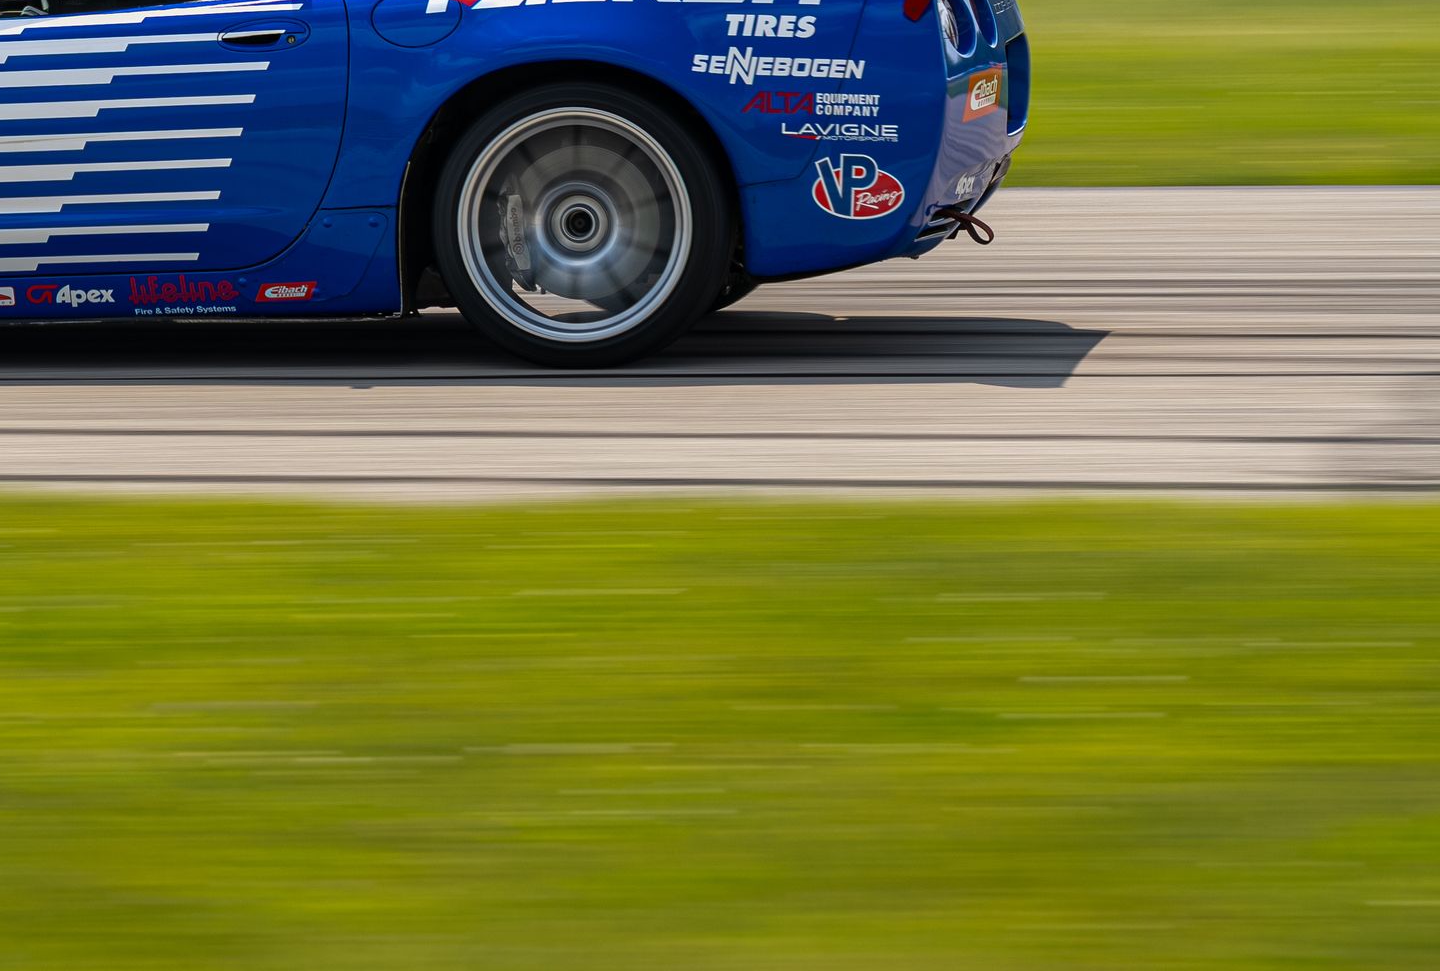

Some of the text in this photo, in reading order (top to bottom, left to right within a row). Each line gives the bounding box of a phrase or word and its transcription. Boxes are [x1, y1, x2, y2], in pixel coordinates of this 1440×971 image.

[726, 13, 817, 39] TIRES
[691, 46, 865, 85] SENNEBOGEN
[741, 90, 880, 115] ALTA EQUIPMENT
[970, 74, 999, 111] Eibach
[815, 104, 880, 117] COMPANY
[781, 122, 899, 137] LAVIGNE
[821, 135, 899, 143] MOTORSPORTS
[815, 153, 878, 219] VP
[855, 190, 903, 211] Racing
[56, 284, 115, 307] Apex
[264, 284, 308, 298] Eibach
[135, 307, 153, 315] Fire
[164, 305, 194, 316] Safety
[196, 304, 237, 314] Systems
